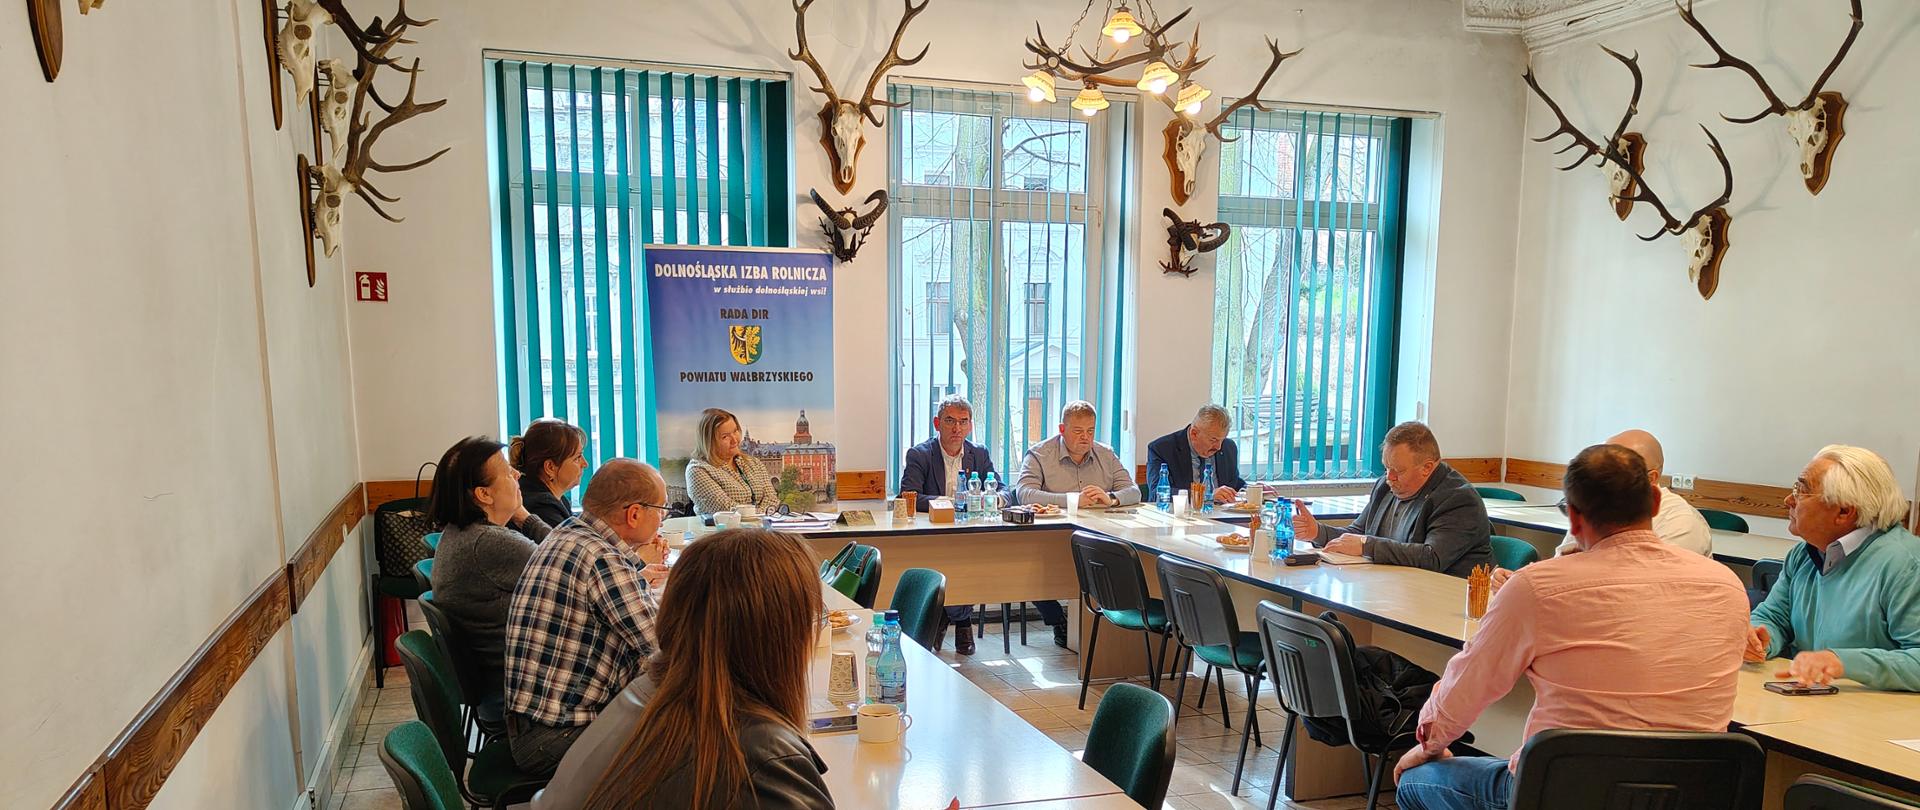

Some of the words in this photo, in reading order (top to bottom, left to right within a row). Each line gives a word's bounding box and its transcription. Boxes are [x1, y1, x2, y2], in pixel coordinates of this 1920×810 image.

[654, 261, 737, 281] DOLNOŚLĄSKA
[741, 265, 768, 280] IZBA
[772, 266, 827, 281] ROLNICZA
[723, 285, 753, 295] służbie
[755, 286, 808, 297] dolnośląskiej
[720, 308, 748, 319] RADA
[752, 308, 769, 320] DIR
[680, 371, 727, 382] POWIATU
[730, 371, 814, 382] WAŁBRZYSKIEGO
